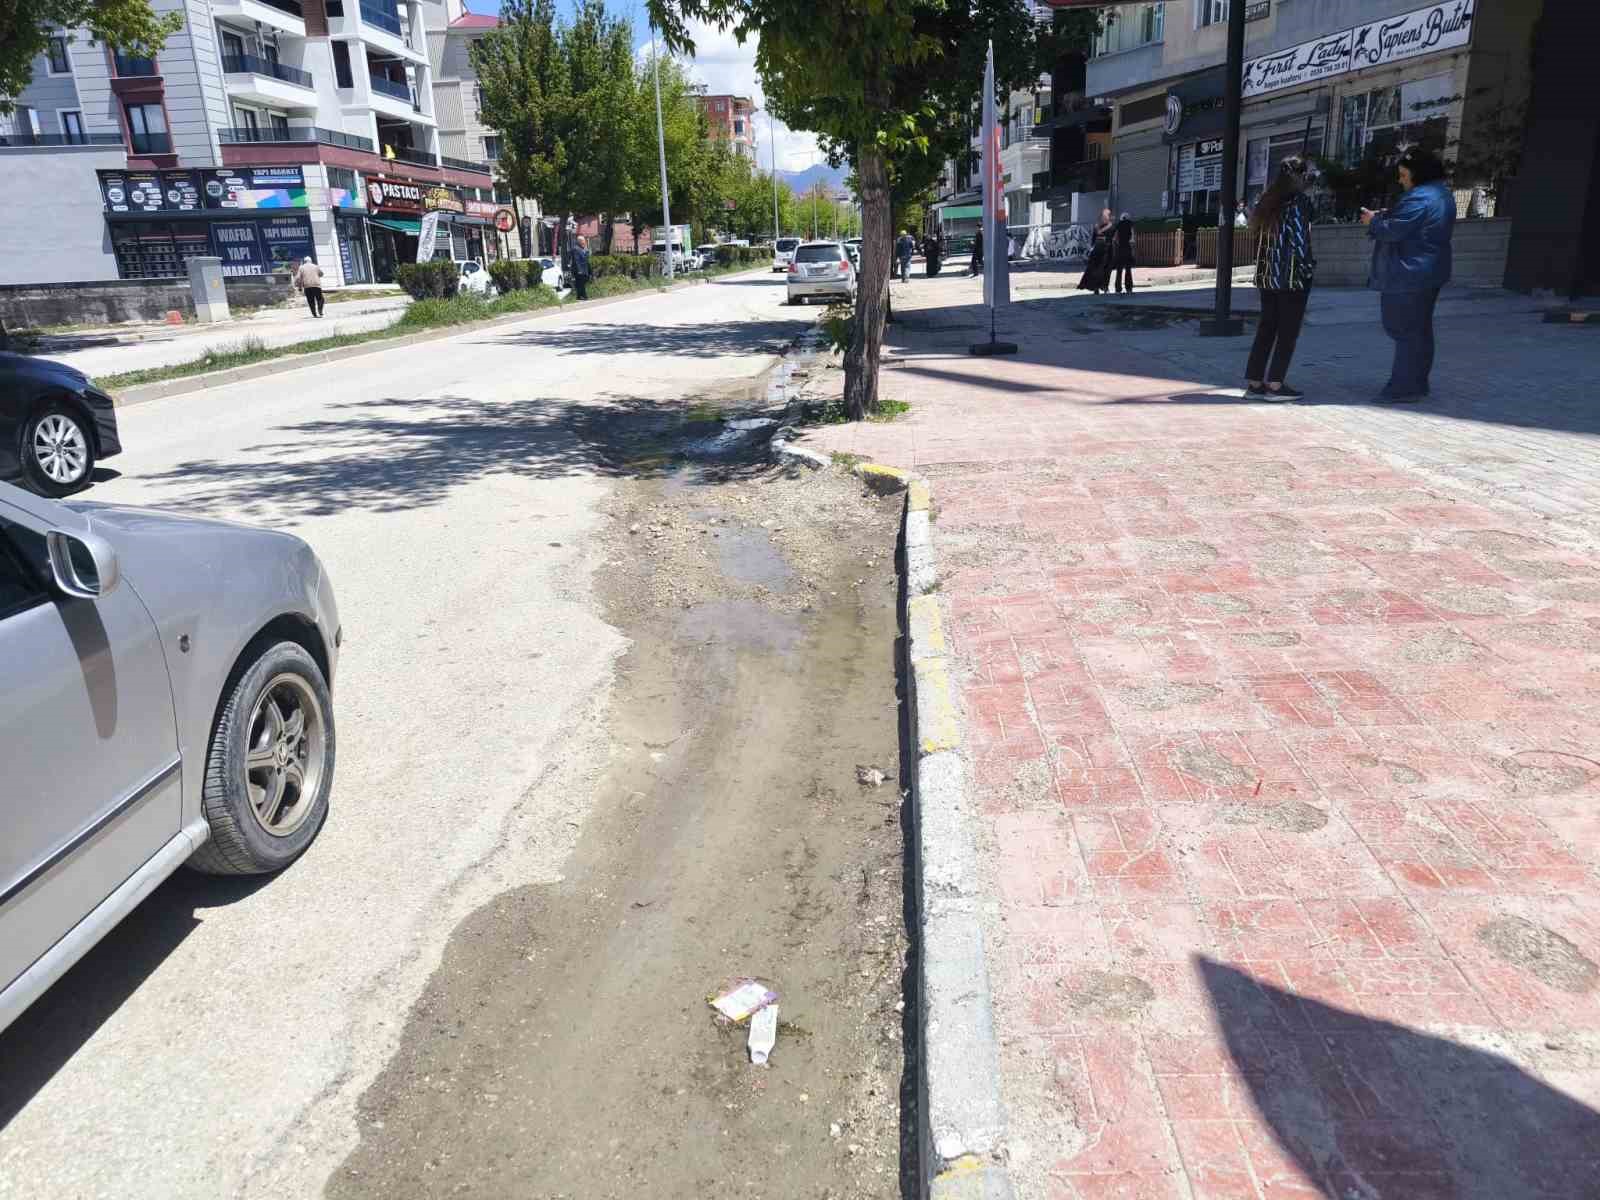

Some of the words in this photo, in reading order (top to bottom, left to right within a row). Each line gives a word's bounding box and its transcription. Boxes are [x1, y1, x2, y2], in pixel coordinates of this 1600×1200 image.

[1256, 48, 1299, 86] First
[1297, 33, 1352, 70] Lady
[381, 182, 421, 200] PASTACI
[216, 228, 255, 242] WAFRA
[263, 228, 280, 238] YAPI
[281, 226, 309, 237] MARKET
[227, 247, 251, 260] YAPI
[222, 265, 262, 277] MARKET
